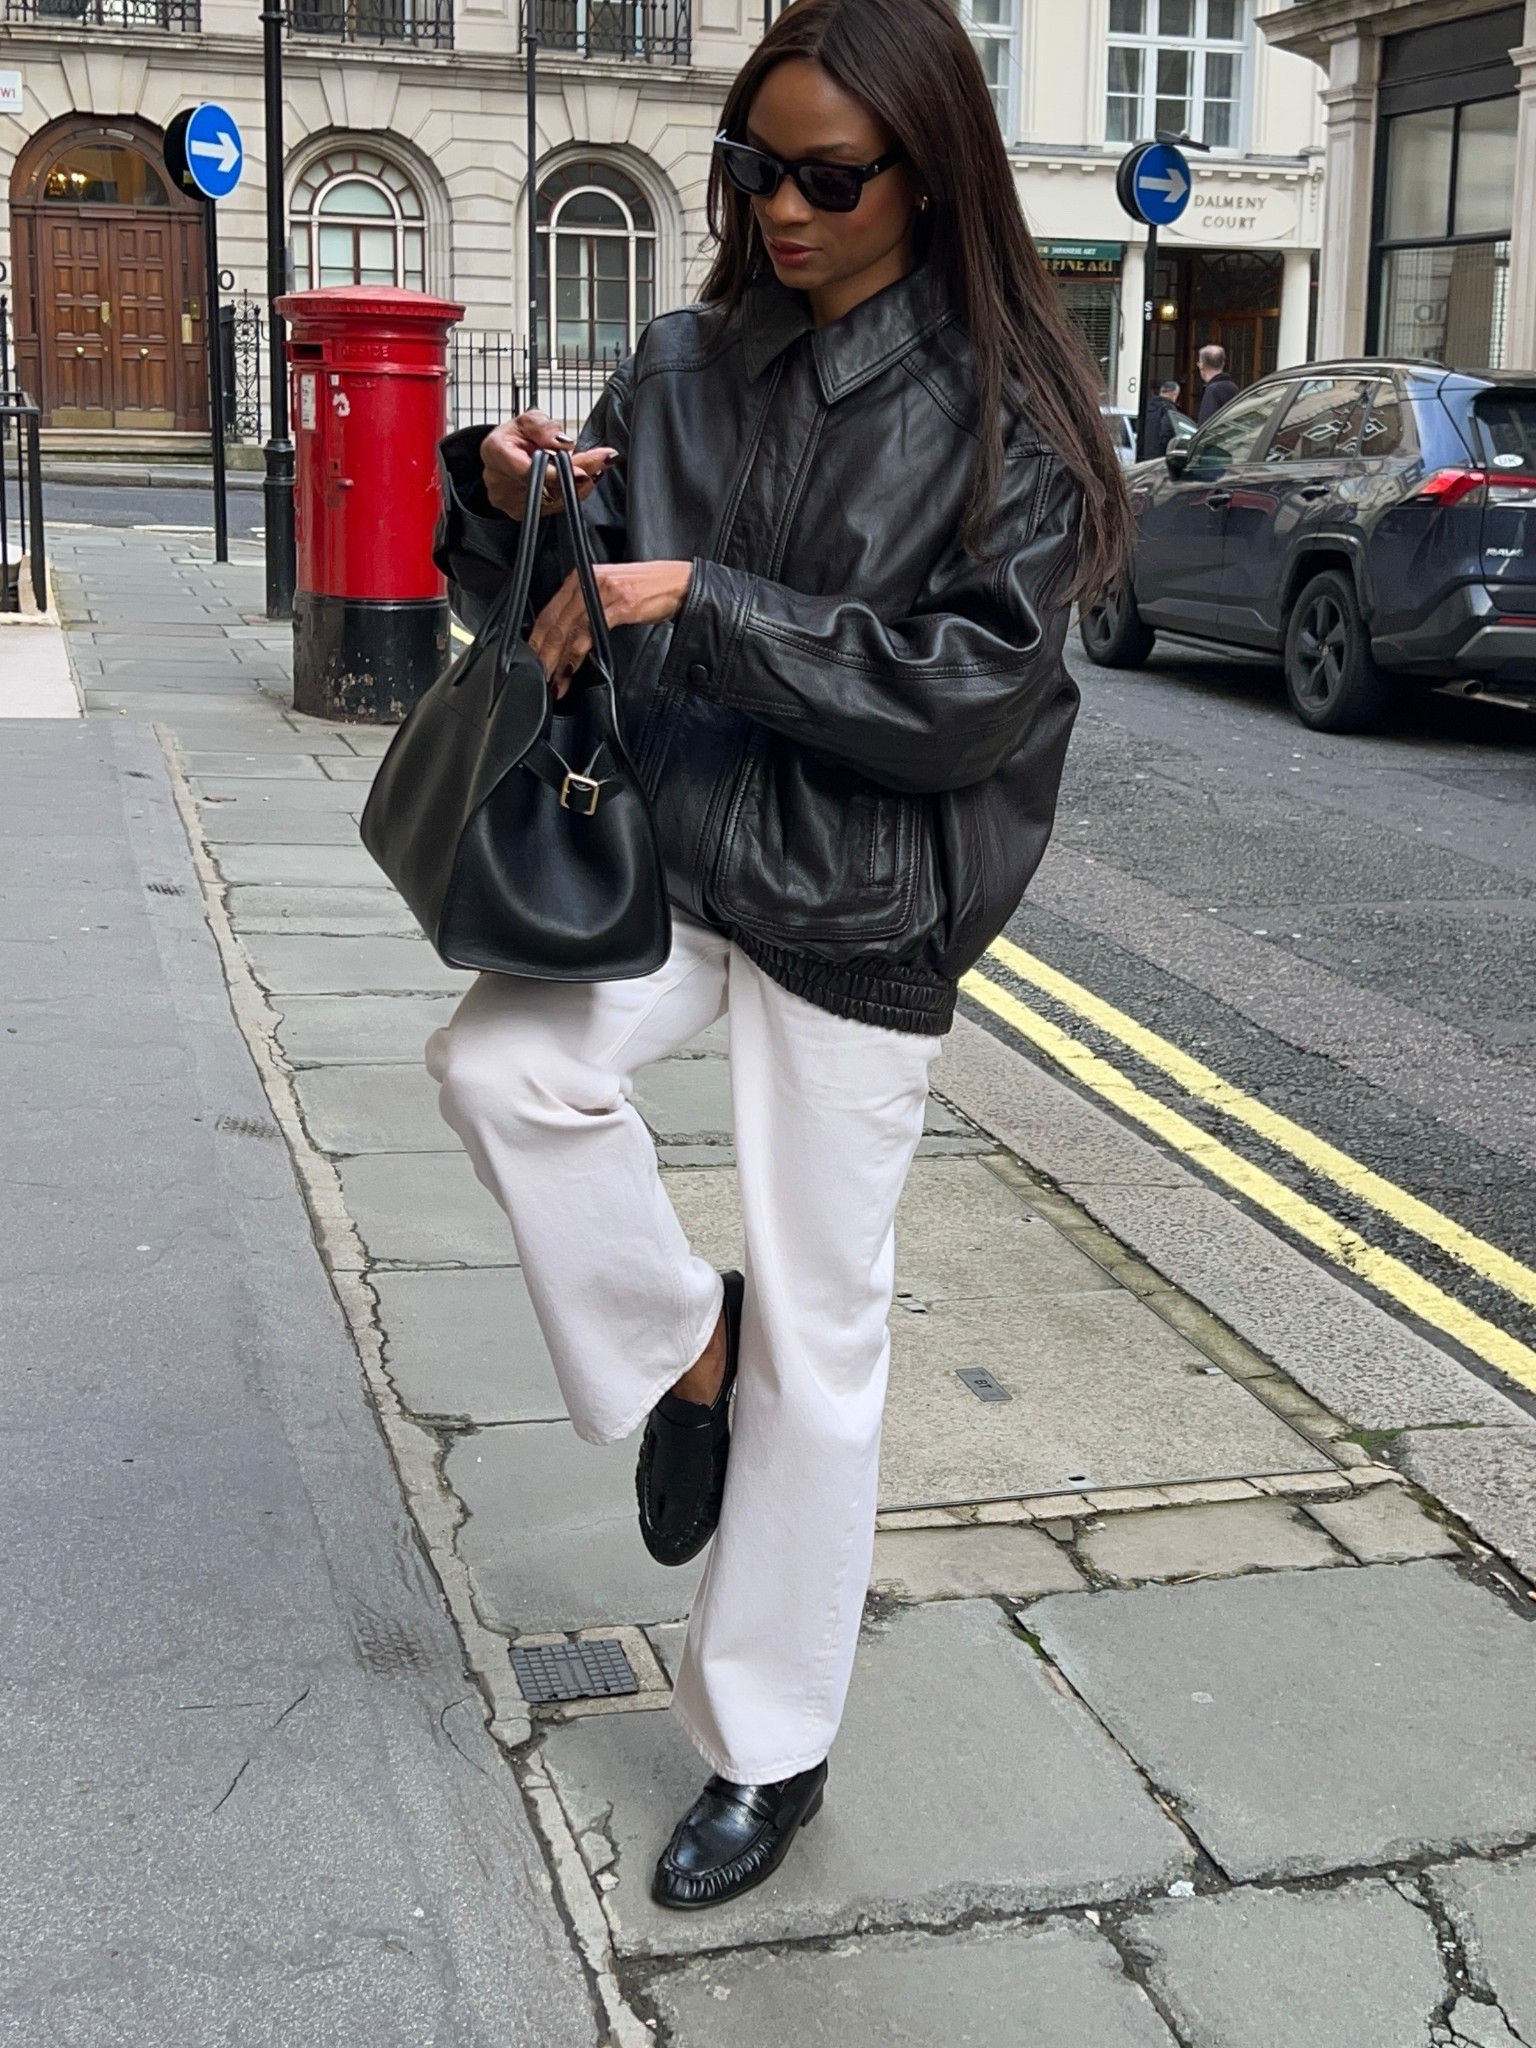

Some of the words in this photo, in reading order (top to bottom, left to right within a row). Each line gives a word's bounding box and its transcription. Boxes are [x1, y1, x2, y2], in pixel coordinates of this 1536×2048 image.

[1194, 194, 1267, 209] DALMENY
[1202, 215, 1256, 229] COURT
[1127, 376, 1137, 394] 8
[1498, 456, 1517, 466] UK
[974, 1379, 993, 1389] BT
